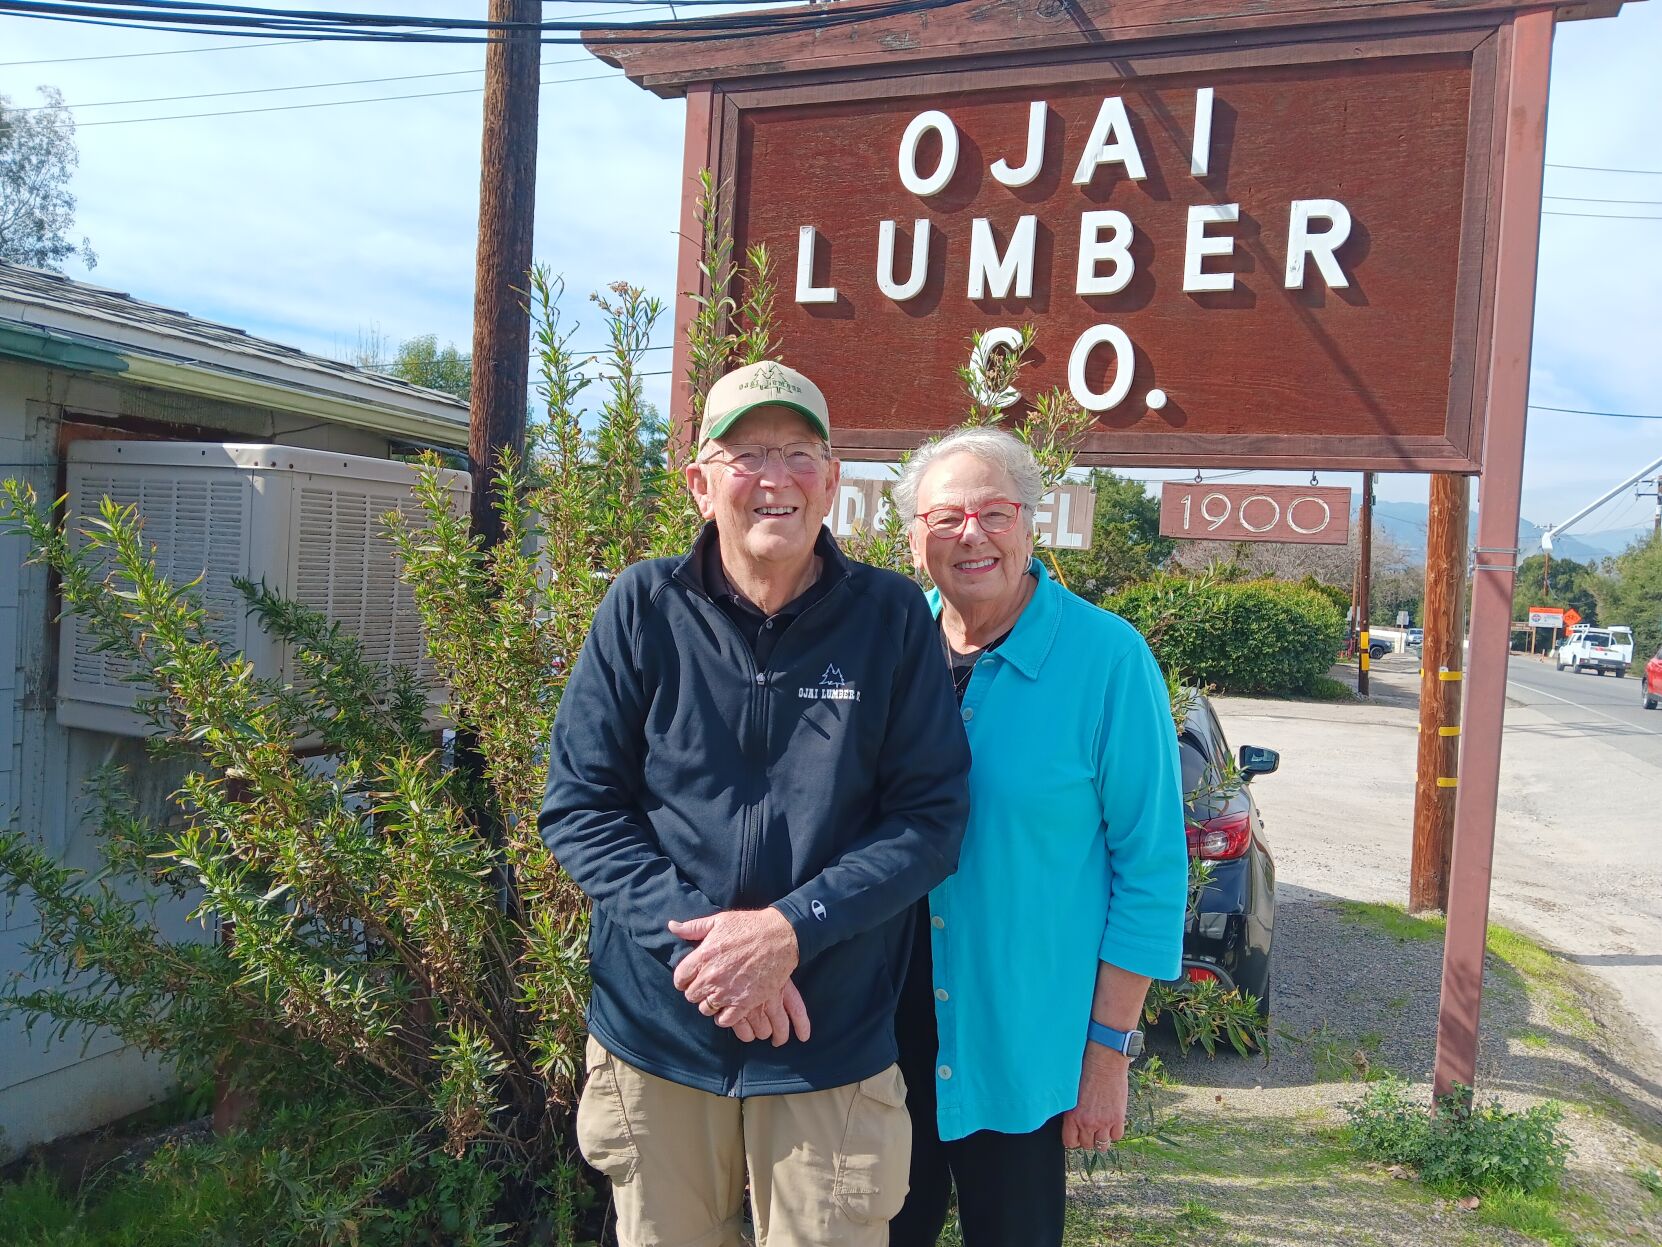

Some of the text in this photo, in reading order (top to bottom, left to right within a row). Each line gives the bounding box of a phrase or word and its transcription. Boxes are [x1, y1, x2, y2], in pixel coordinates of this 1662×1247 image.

[898, 87, 1214, 196] OJAI
[795, 198, 1353, 303] LUMBER
[969, 323, 1168, 412] CO.
[1180, 492, 1330, 534] 1900
[798, 687, 819, 699] OJAI
[821, 688, 855, 700] LUMBER
